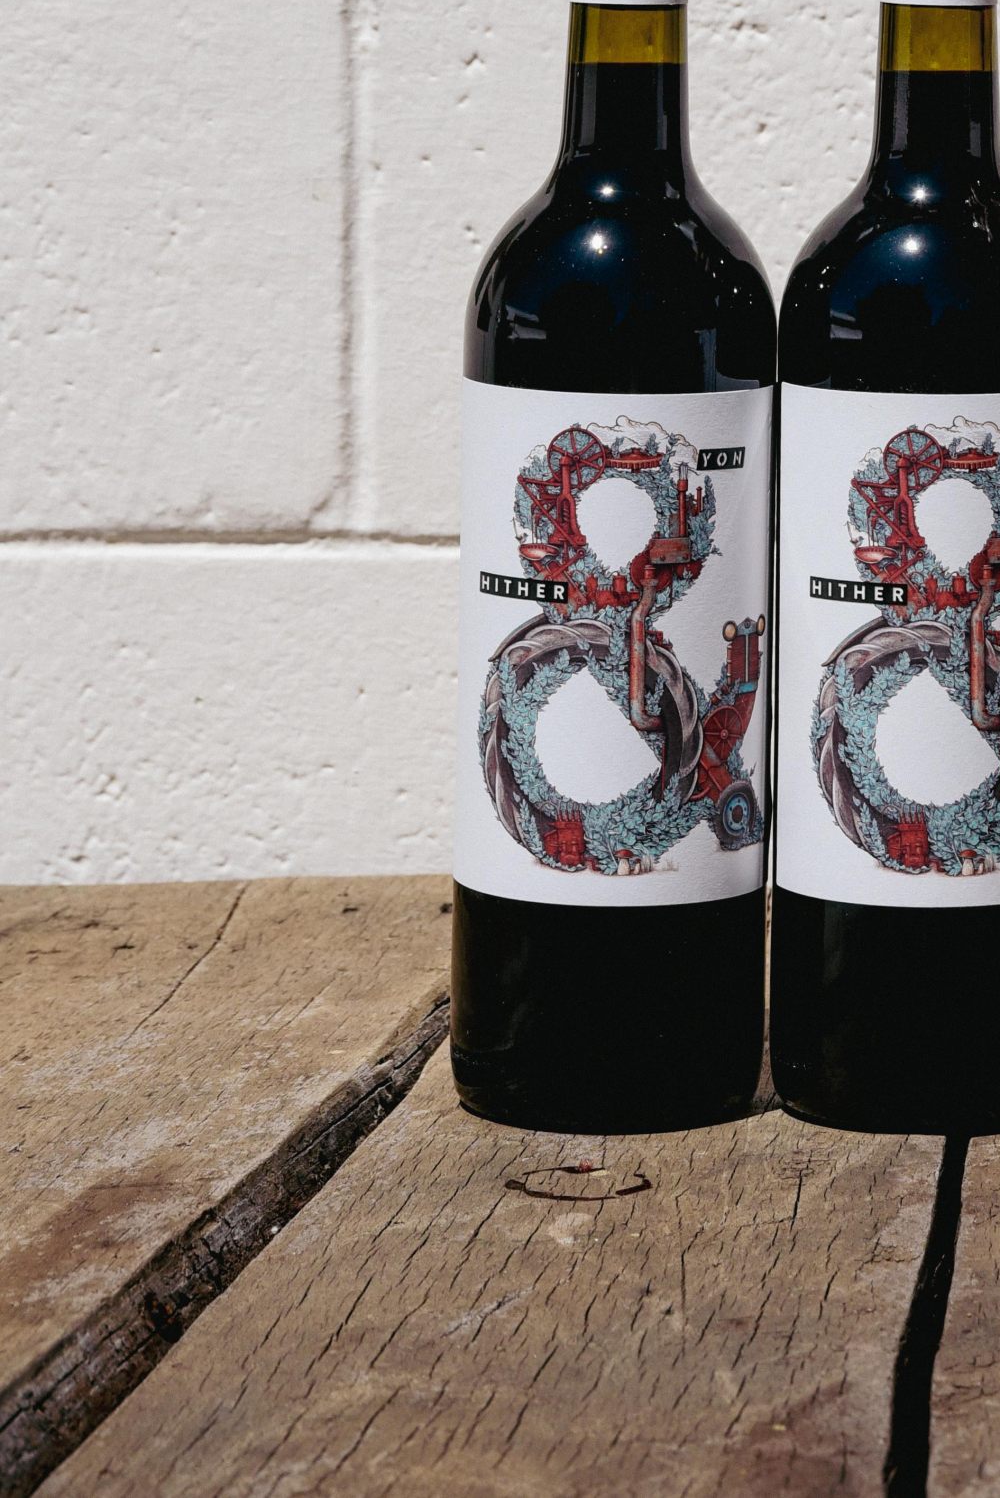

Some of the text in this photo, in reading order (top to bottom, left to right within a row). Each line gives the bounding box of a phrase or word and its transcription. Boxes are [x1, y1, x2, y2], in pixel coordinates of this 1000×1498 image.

[702, 450, 743, 468] YON
[481, 574, 566, 600] HITHER
[812, 580, 904, 602] HITHER
